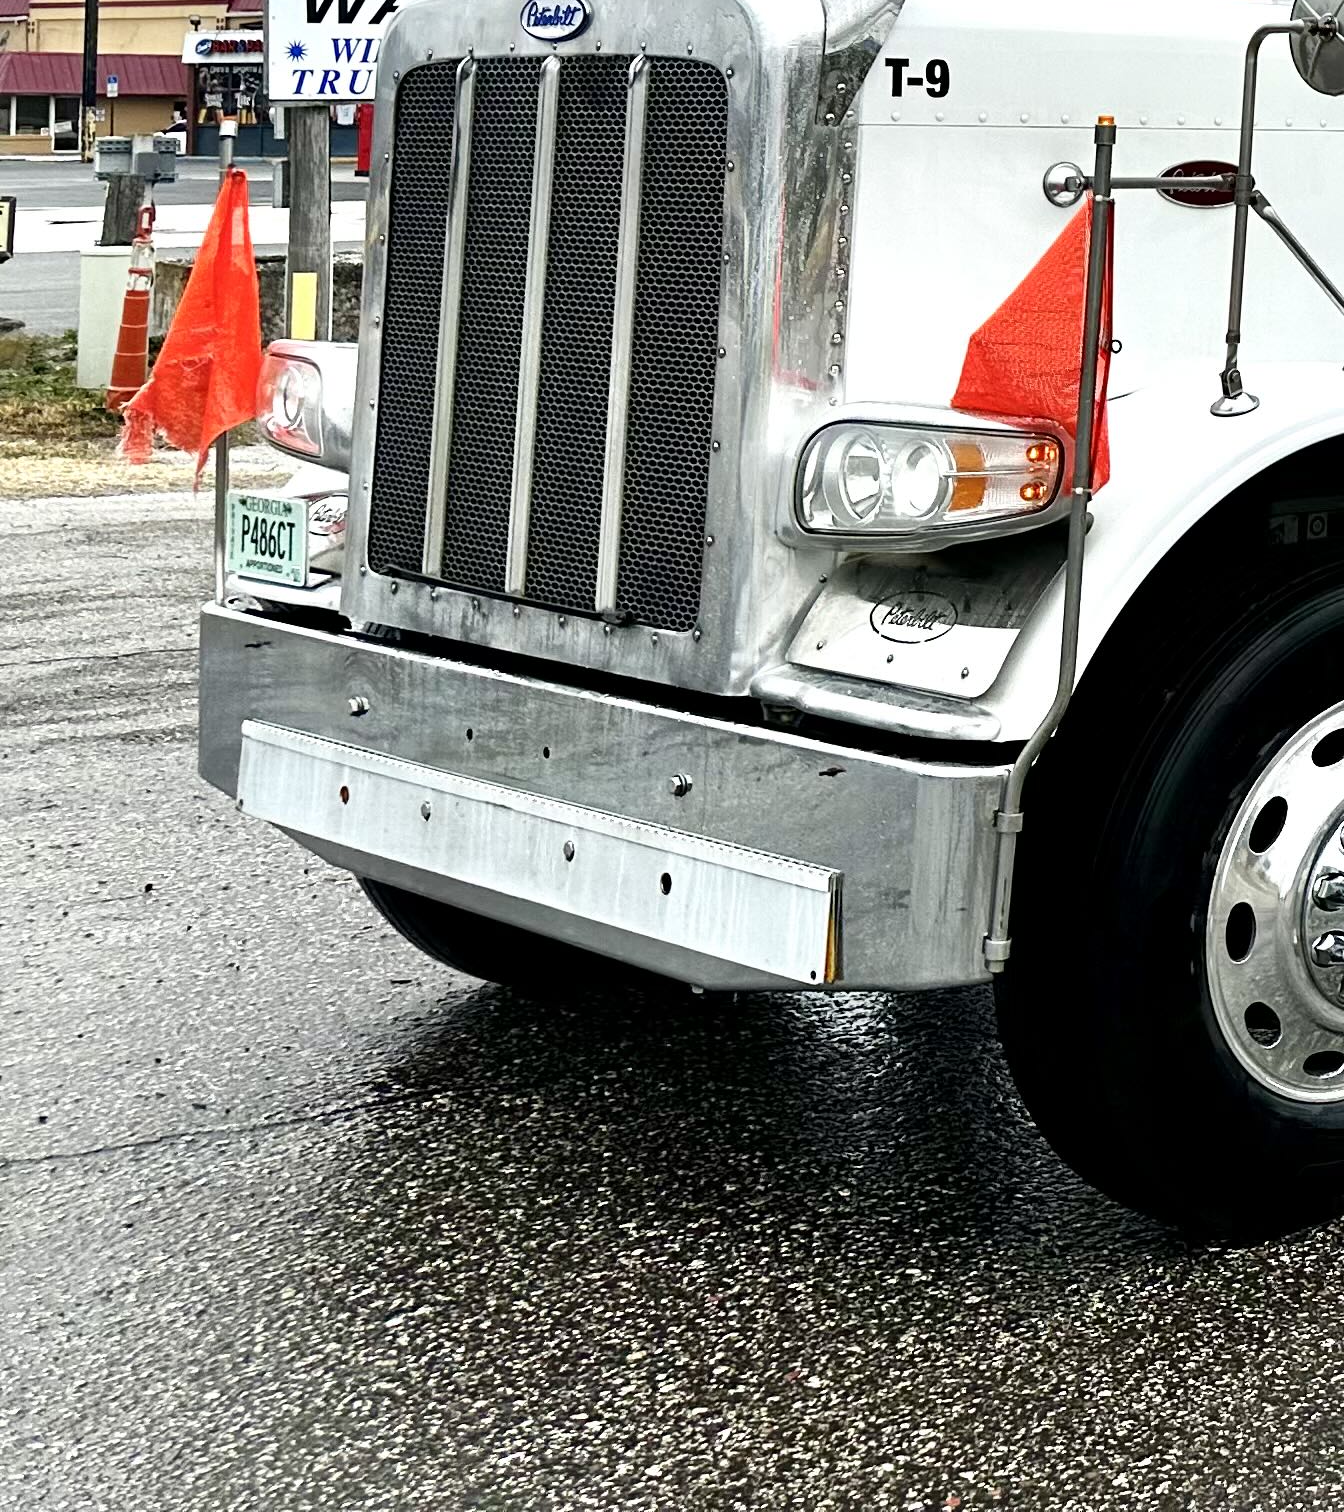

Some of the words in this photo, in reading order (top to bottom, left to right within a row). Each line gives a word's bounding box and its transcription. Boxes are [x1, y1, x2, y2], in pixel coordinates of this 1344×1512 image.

[526, 1, 582, 27] Peterbilt
[885, 57, 951, 98] T-9
[241, 513, 296, 562] P486CT
[881, 601, 948, 631] Peterbilt
